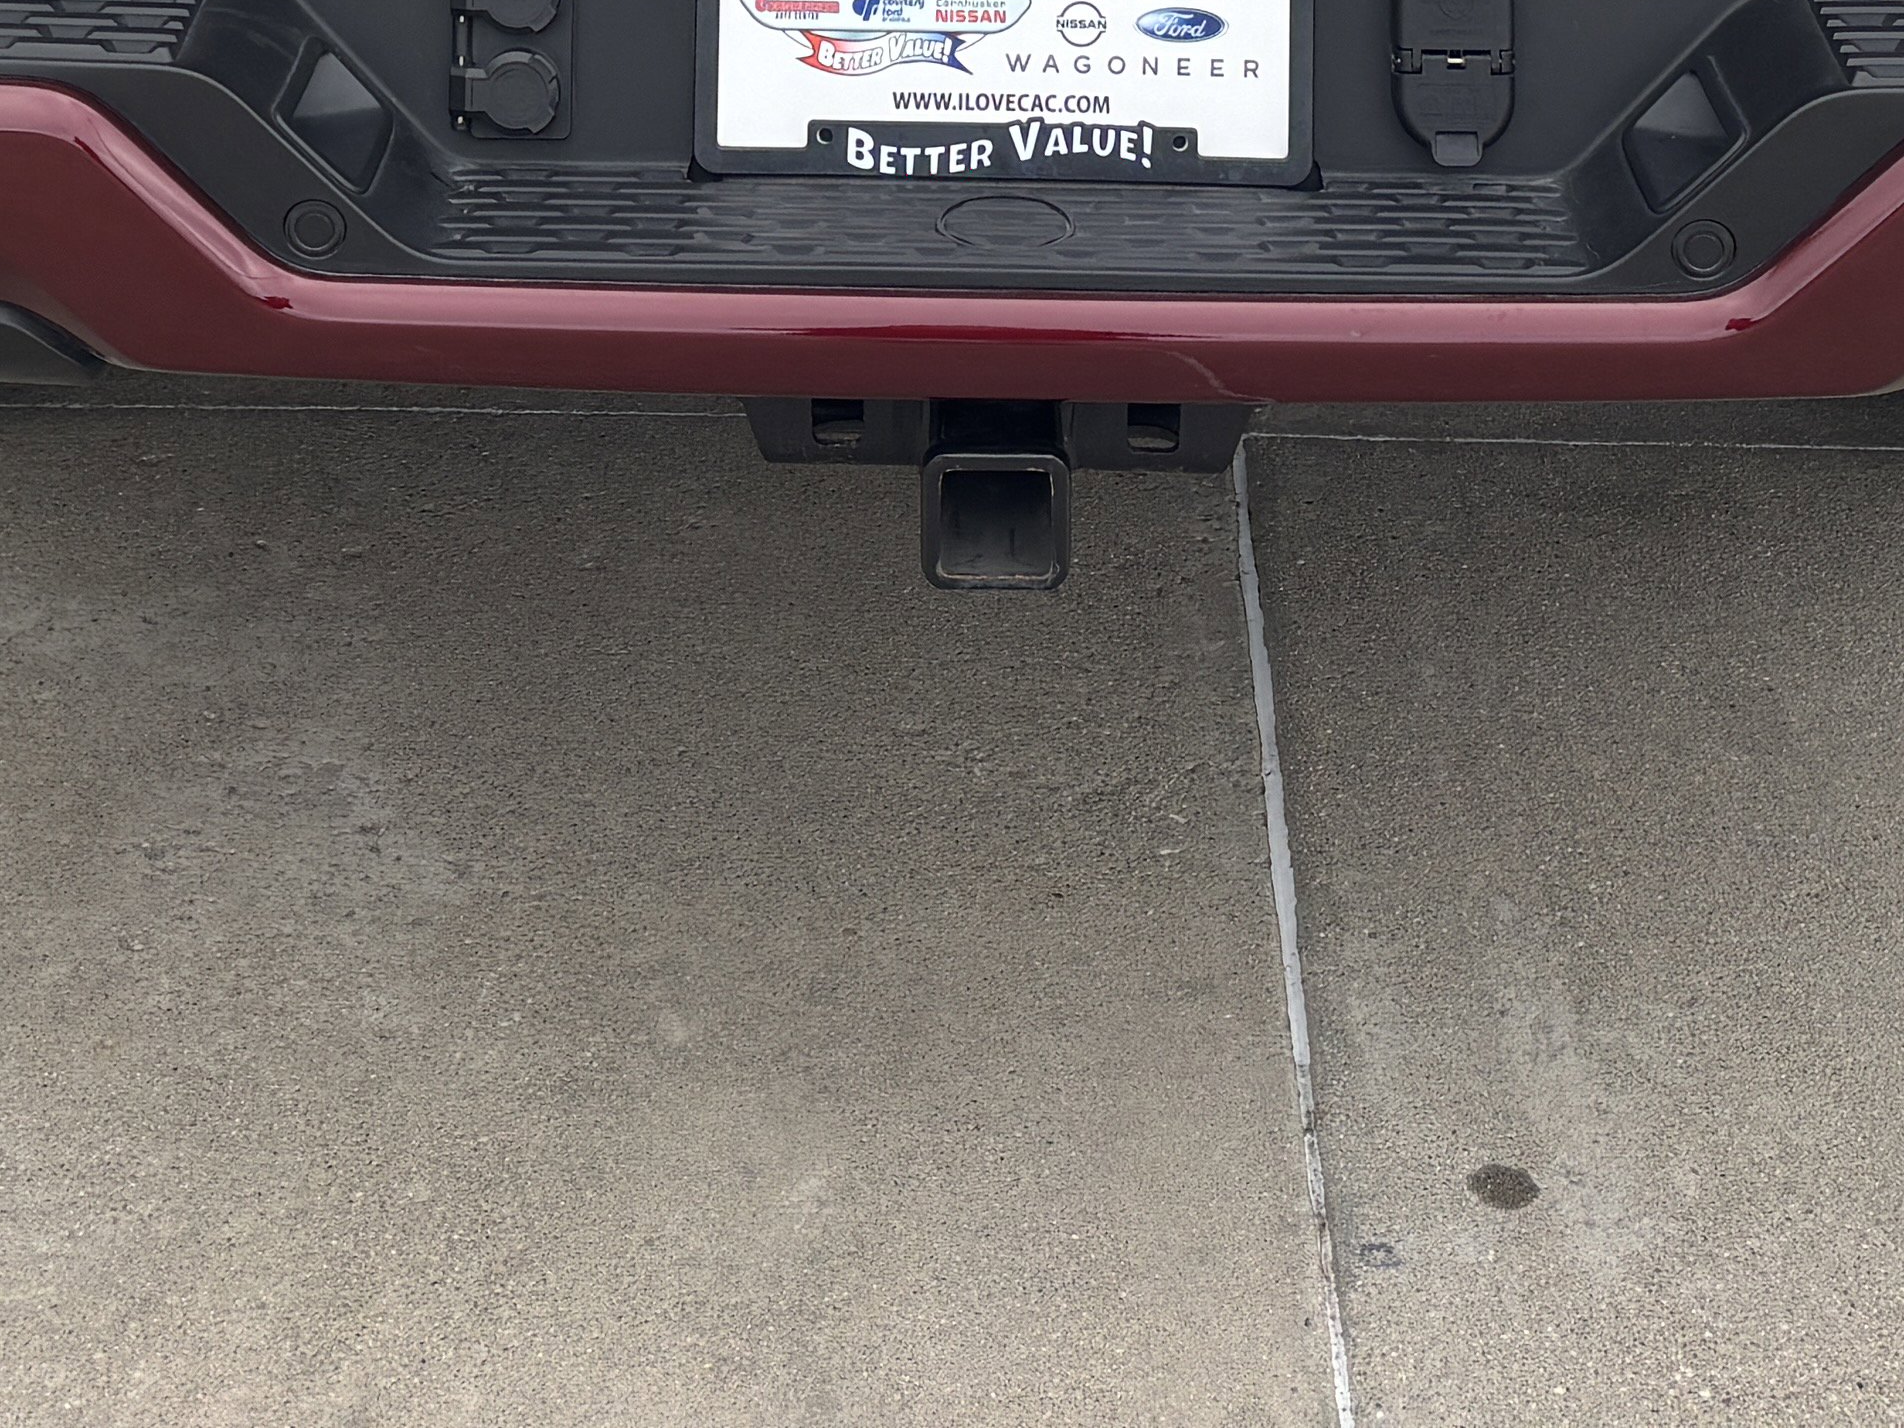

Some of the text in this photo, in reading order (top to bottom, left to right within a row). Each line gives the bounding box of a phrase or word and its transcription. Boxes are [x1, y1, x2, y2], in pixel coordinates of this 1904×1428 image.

[935, 9, 1007, 23] NISSAN
[1056, 18, 1107, 30] NISSAN
[1153, 13, 1206, 38] Ford
[816, 39, 884, 71] BETTER
[1005, 53, 1260, 78] WAGONEER
[892, 90, 1111, 114] WWW.ILOVECAC.COM
[846, 121, 1154, 175] BETTER VALUE!
